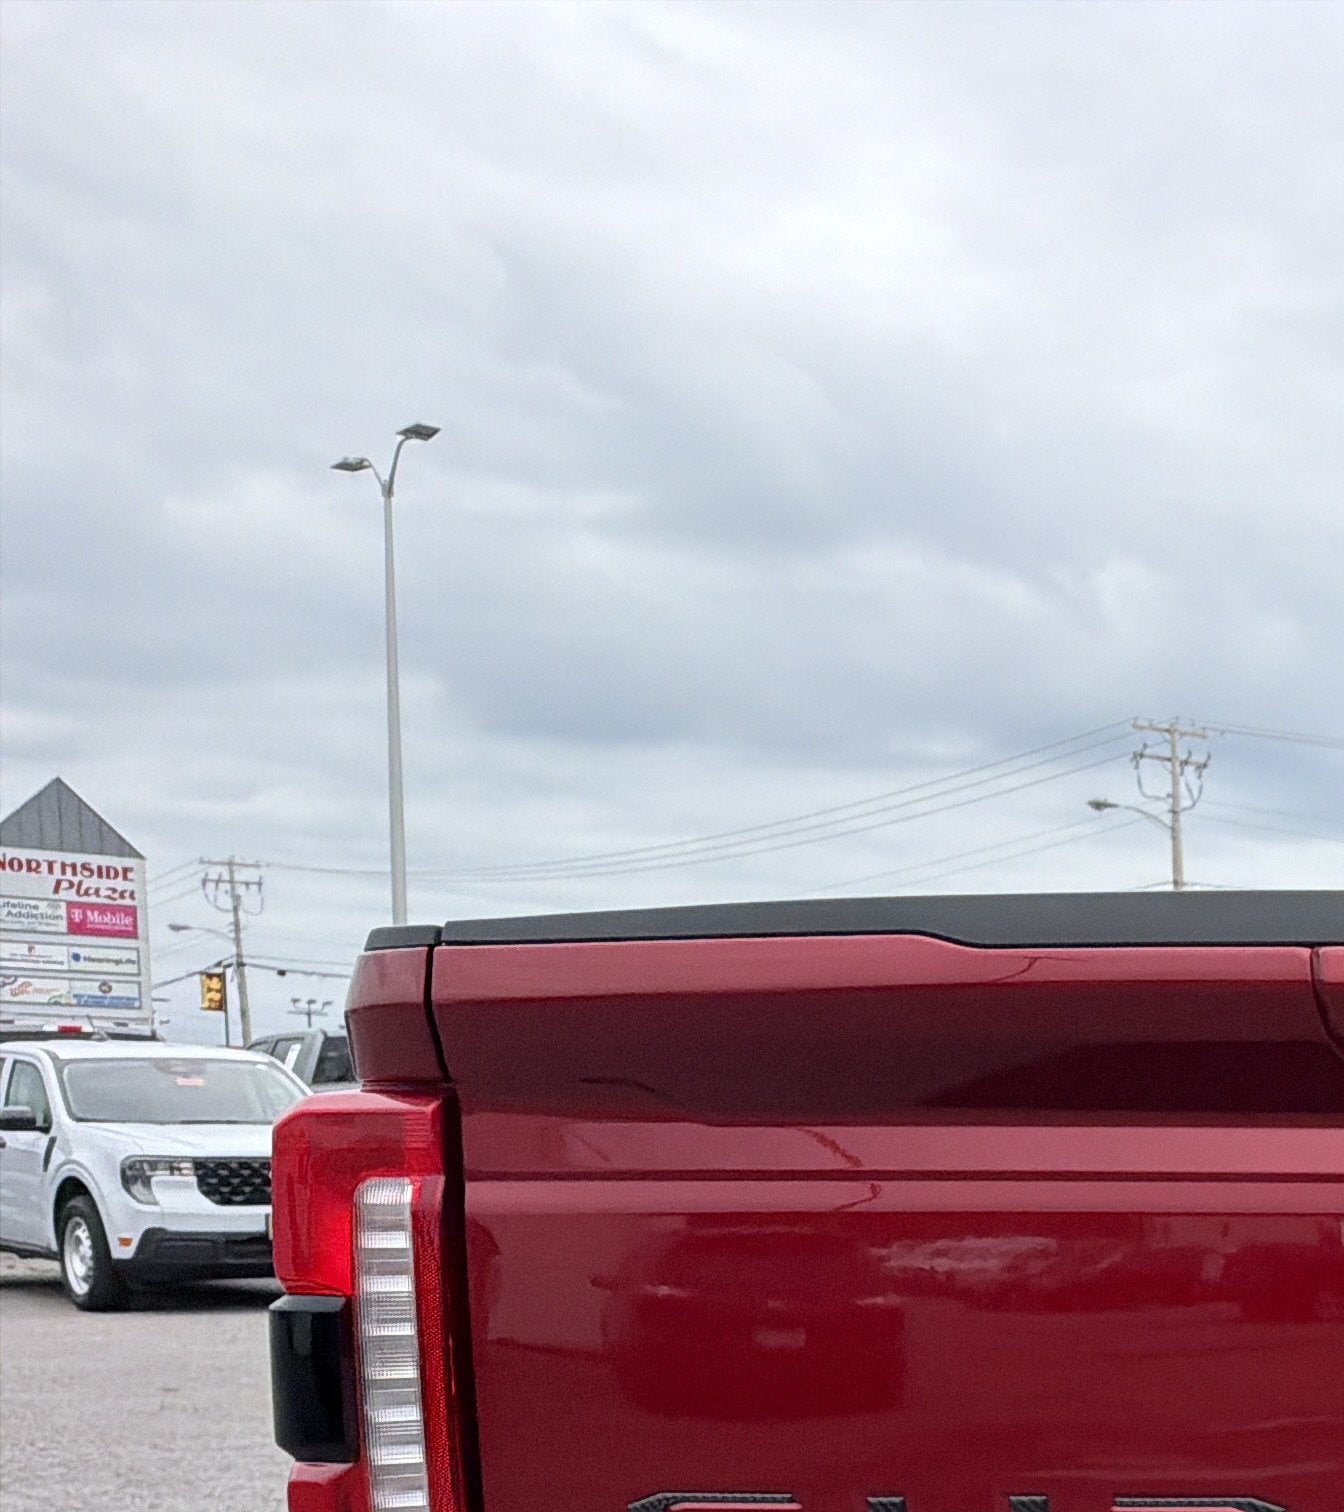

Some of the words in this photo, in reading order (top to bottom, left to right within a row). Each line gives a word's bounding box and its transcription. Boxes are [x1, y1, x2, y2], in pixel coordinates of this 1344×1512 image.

[53, 878, 136, 901] Plaza
[0, 901, 39, 910] ifeline
[5, 909, 63, 921] Addiction
